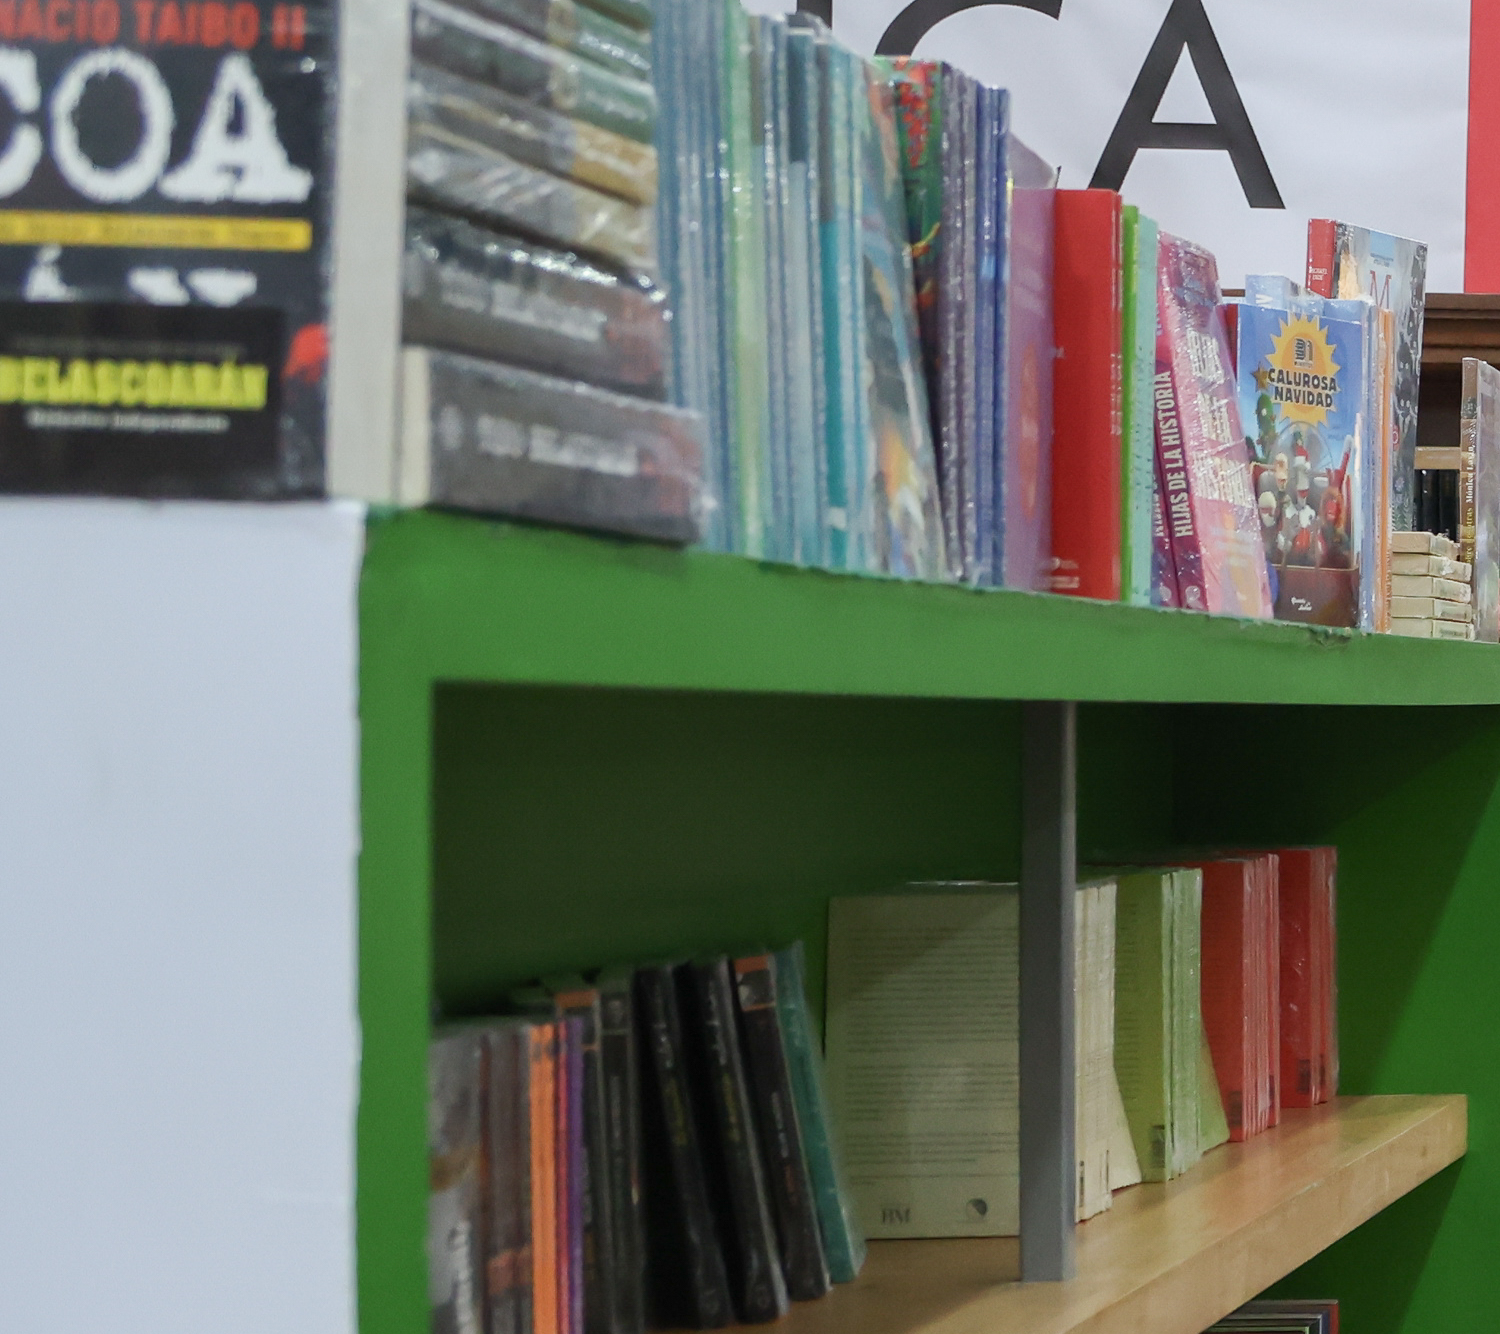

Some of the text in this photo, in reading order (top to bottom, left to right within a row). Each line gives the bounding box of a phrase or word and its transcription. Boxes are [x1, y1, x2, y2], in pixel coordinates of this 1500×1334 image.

[272, 3, 307, 50] II
[1268, 366, 1338, 392] CALUROSA
[1274, 385, 1334, 408] NAVIDAD
[1154, 370, 1193, 538] HIJAS DE LA HISTORIA
